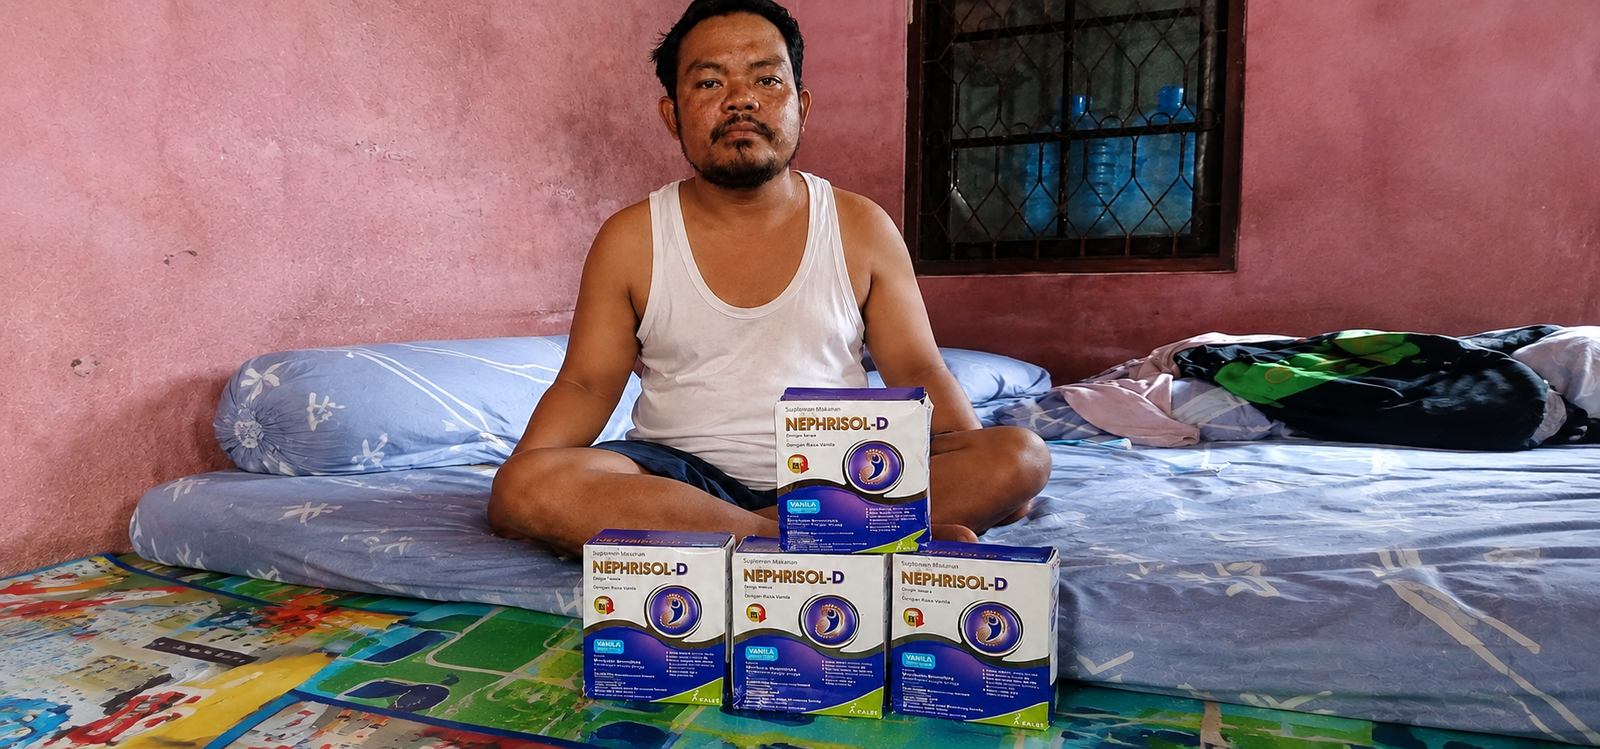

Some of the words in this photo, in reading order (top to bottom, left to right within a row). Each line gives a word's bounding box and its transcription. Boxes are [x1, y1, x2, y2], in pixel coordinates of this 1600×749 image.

[785, 416, 889, 431] NEPHRISOL-D
[592, 560, 689, 576] NEPHRISOL-D
[743, 568, 845, 585] NEPHRISOL-D
[901, 570, 1009, 591] NEPHRISOL-D
[748, 647, 775, 655] VANILA
[905, 654, 932, 663] VANILA
